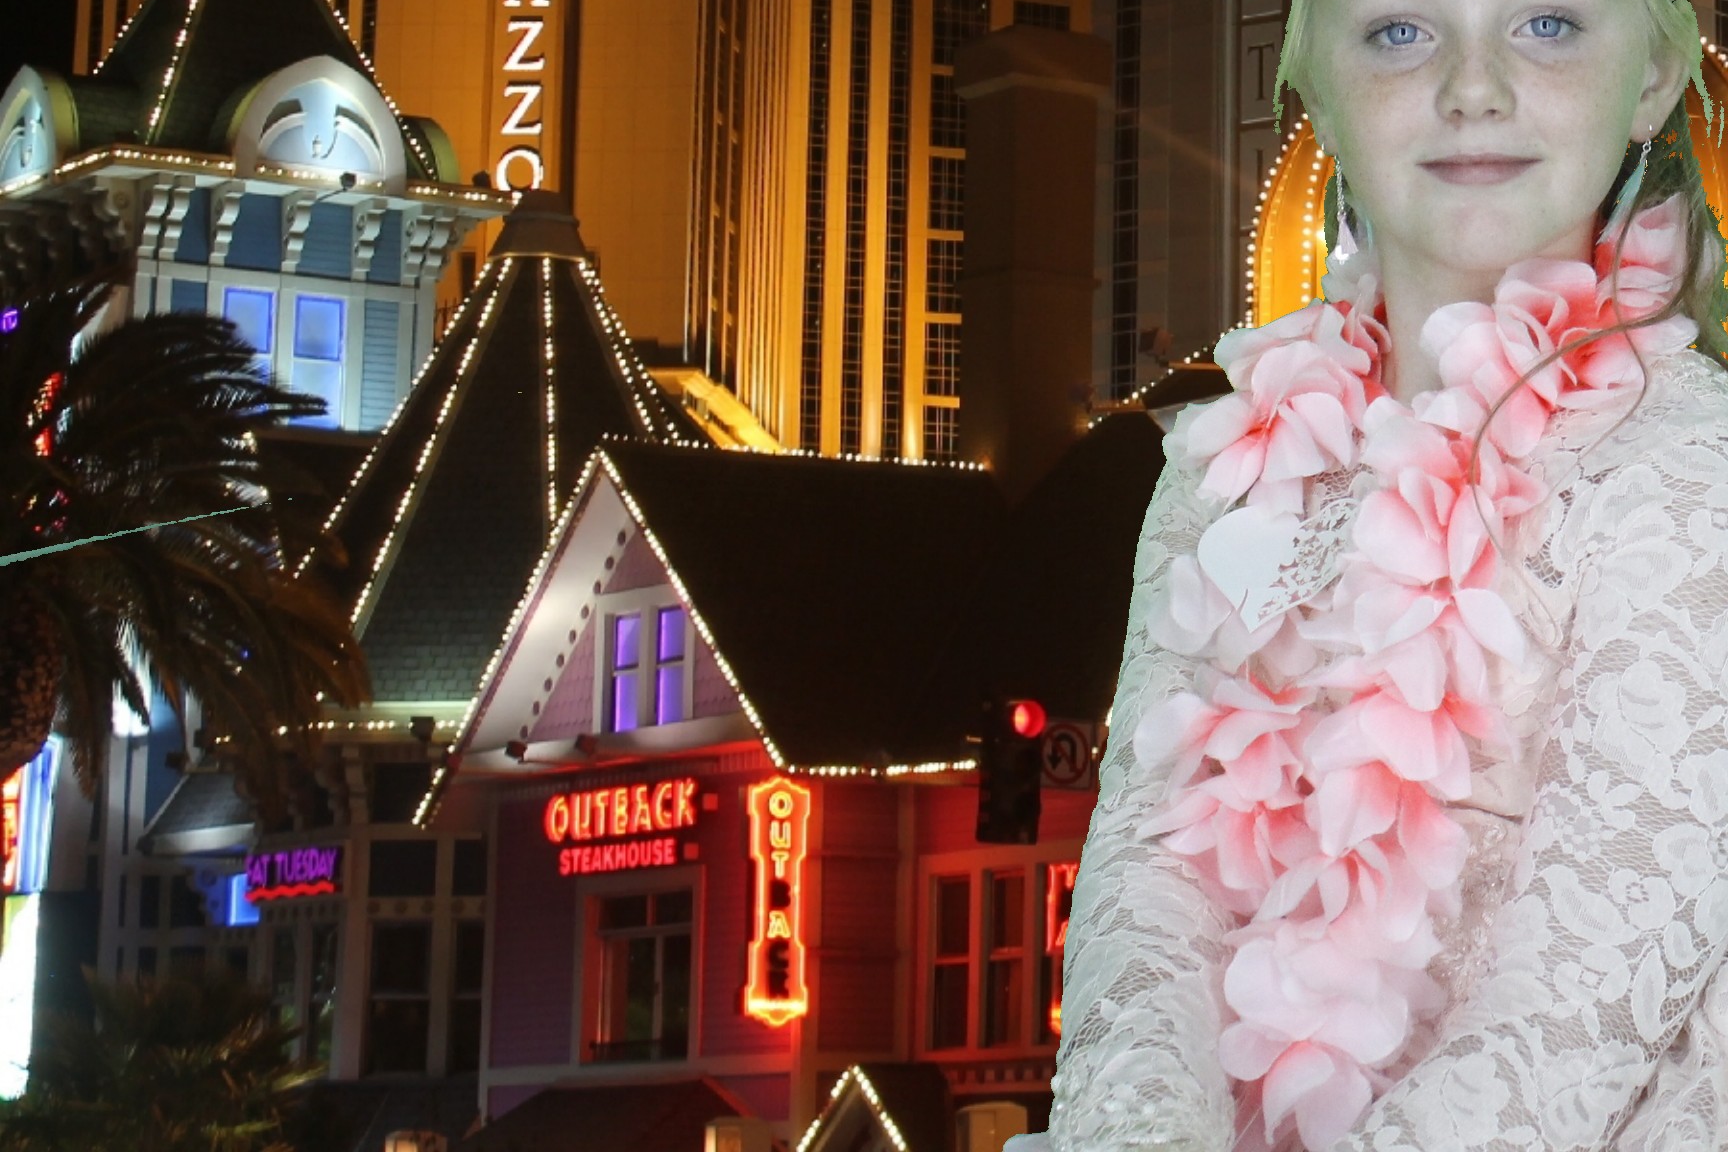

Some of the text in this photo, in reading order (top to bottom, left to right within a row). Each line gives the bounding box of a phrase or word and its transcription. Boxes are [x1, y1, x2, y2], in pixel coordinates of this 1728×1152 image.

[544, 777, 697, 843] OUTBACK
[274, 846, 338, 882] TUESDAY
[559, 838, 678, 876] STEAKHOUSE
[766, 791, 794, 998] OUTBACK
